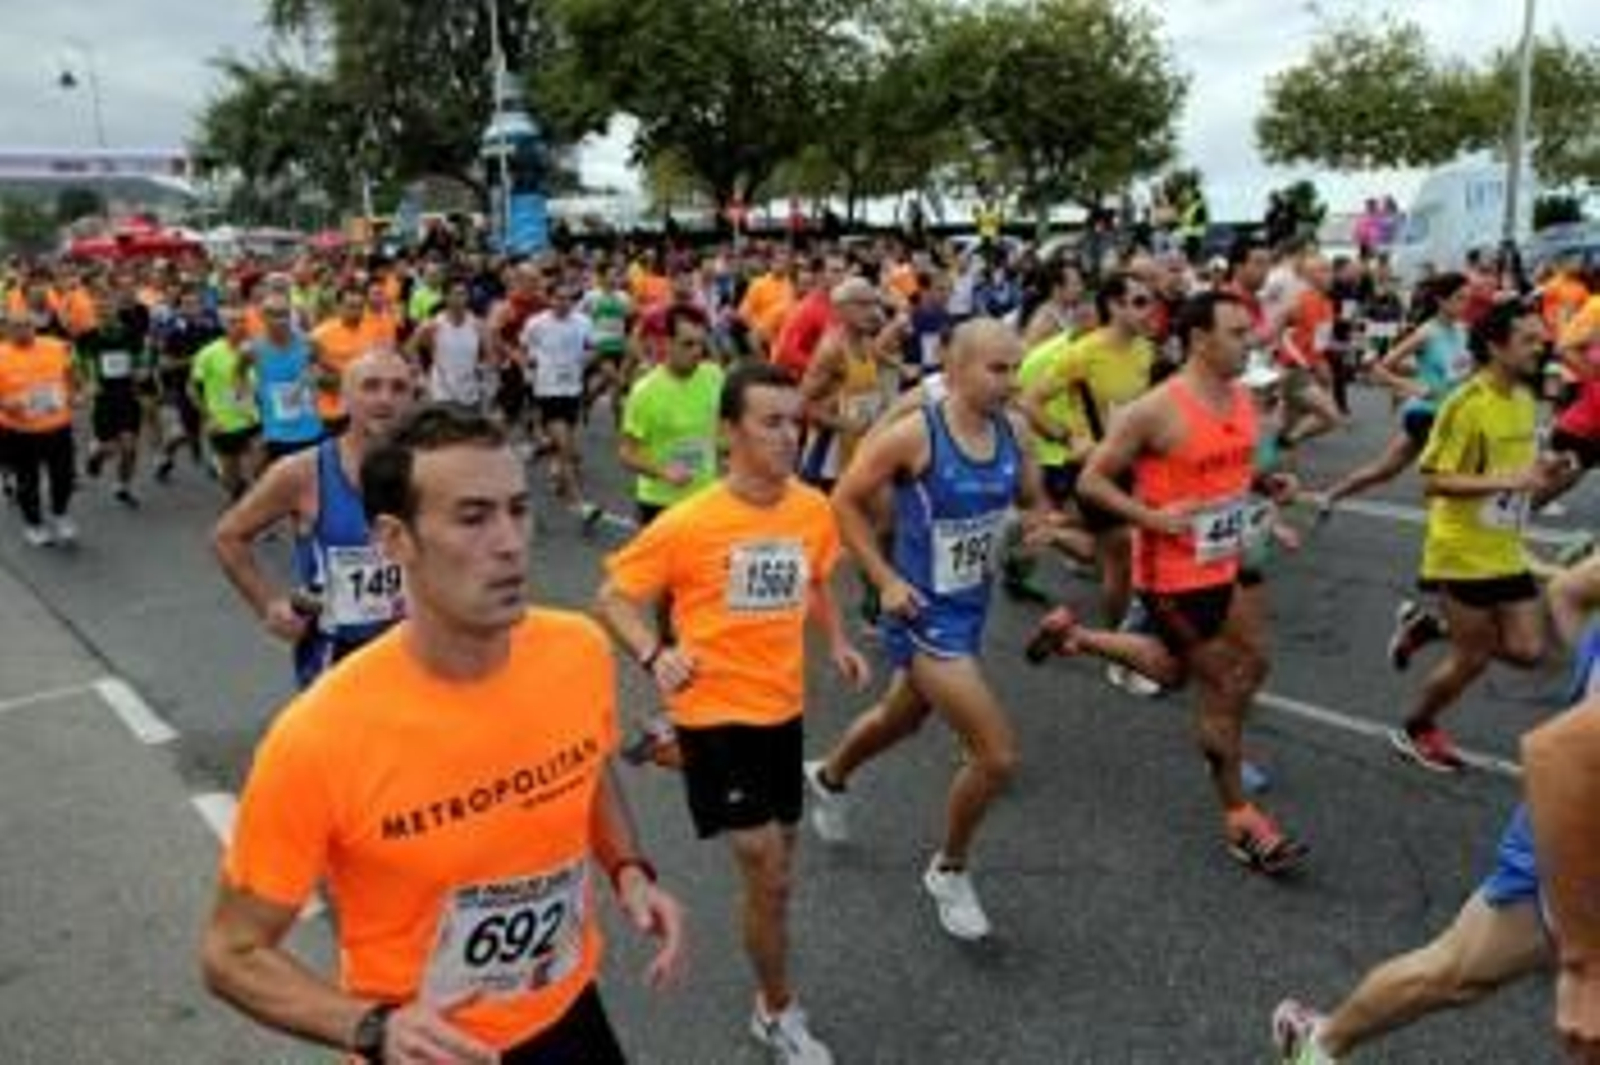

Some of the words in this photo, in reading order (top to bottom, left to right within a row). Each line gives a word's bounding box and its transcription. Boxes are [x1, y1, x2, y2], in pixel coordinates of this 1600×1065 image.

[348, 563, 402, 603] 149
[380, 738, 598, 842] METROPOLITAN
[464, 901, 563, 969] 692
